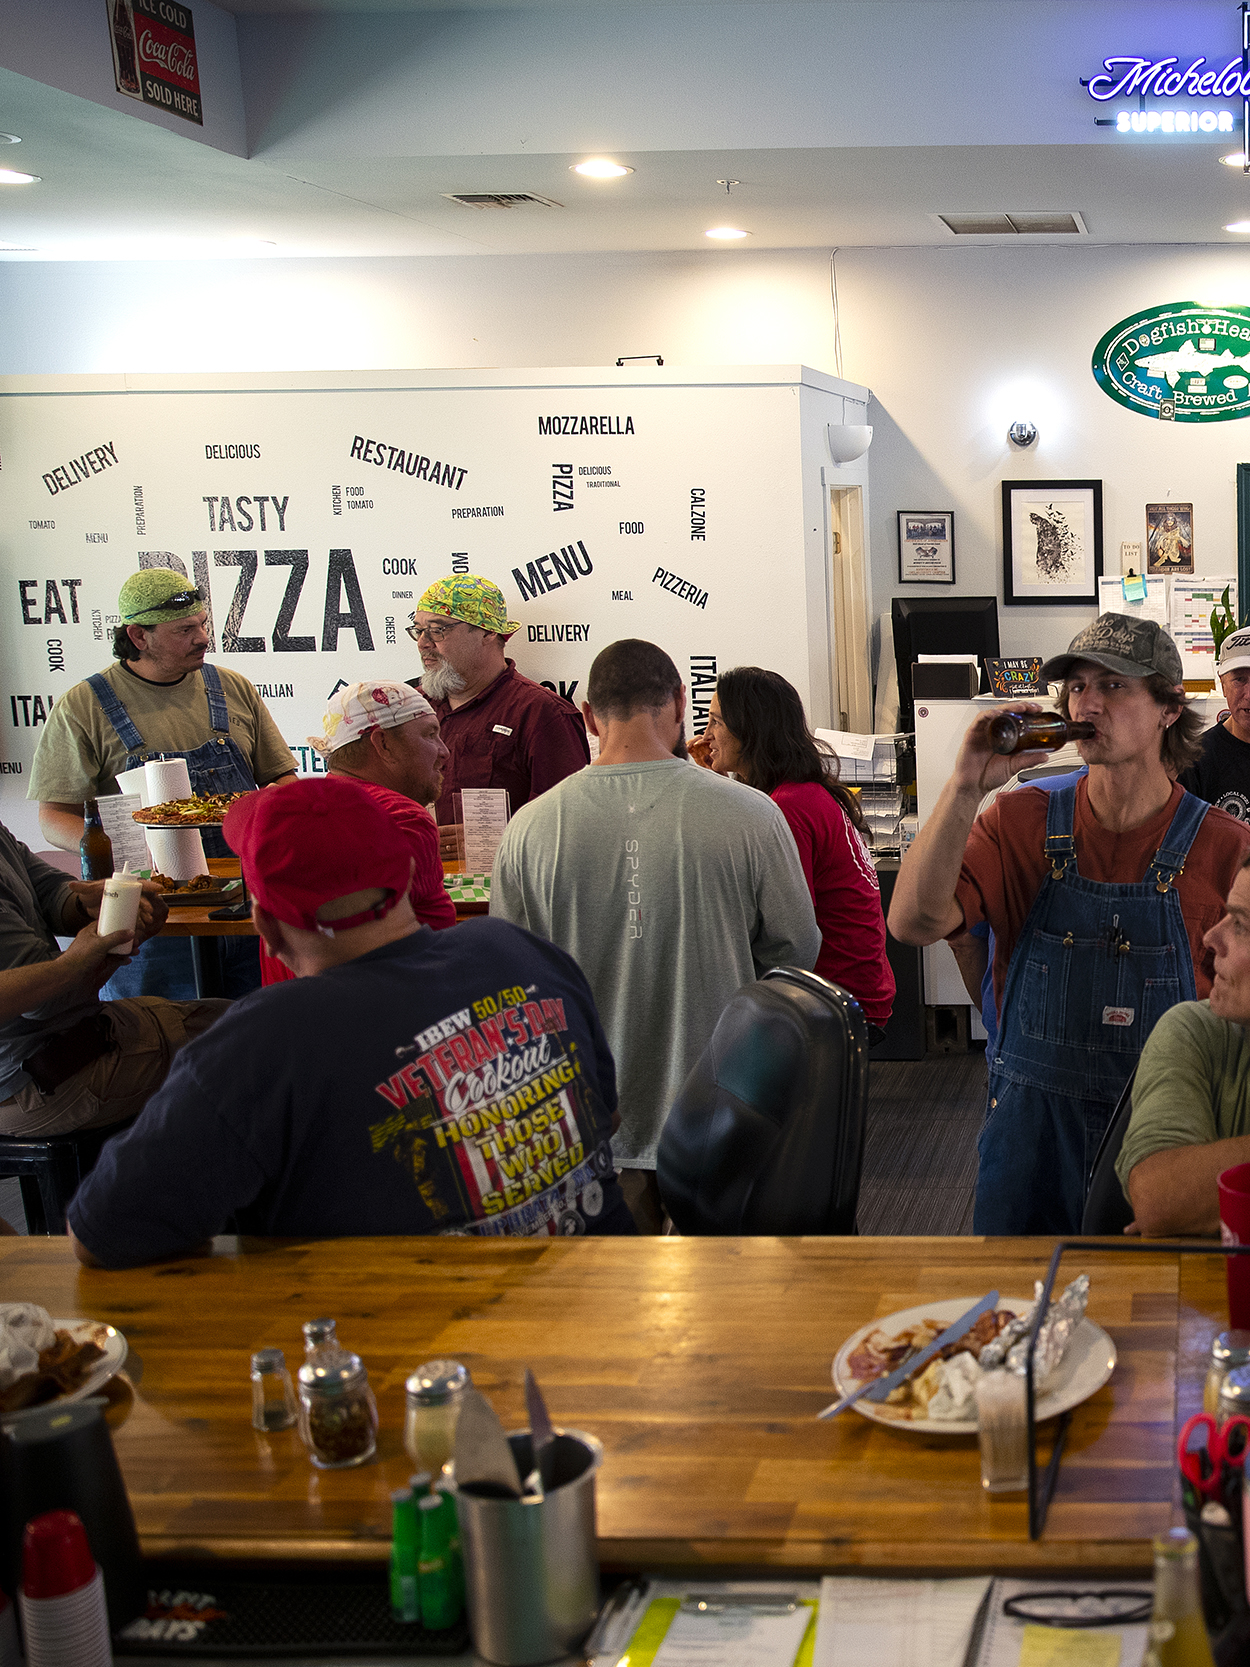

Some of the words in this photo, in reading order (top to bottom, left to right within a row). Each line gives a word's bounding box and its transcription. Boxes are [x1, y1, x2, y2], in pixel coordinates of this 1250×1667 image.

[160, 2, 187, 29] COLD
[145, 80, 172, 105] SOLD
[173, 91, 199, 117] HERE
[1116, 110, 1234, 133] SUPERIOR
[1121, 370, 1163, 400] Craft
[1172, 389, 1238, 406] Brewed
[538, 416, 635, 435] MOZZARELLA
[205, 444, 261, 459] DELICIOUS
[350, 435, 468, 491] RESTAURANT
[41, 441, 120, 496] DELIVERY
[578, 466, 612, 476] DELICIOUS
[332, 484, 343, 516] KITCHEN
[345, 486, 365, 497] FOOD
[552, 463, 574, 512] PIZZA
[136, 485, 147, 536] PREPARATION
[202, 496, 290, 532] TASTY
[346, 499, 375, 510] TOMATO
[451, 506, 504, 519] PREPARATION
[690, 488, 706, 542] CALZONE
[28, 519, 56, 531] TOMATO
[85, 532, 109, 544] MENU
[619, 521, 644, 535] FOOD
[382, 558, 418, 576] COOK
[511, 540, 594, 602] MENU
[18, 579, 83, 626] EAT
[392, 590, 414, 600] DINNER
[611, 591, 634, 602] MEAL
[652, 566, 710, 610] PIZZERIA
[91, 609, 104, 641] KITCHEN
[385, 616, 397, 645] CHEESE
[527, 624, 590, 643] DELIVERY
[46, 639, 66, 673] COOK
[1008, 661, 1020, 669] MAY
[1020, 660, 1028, 669] BE
[1004, 671, 1034, 682] CRAZY
[625, 839, 643, 939] SPYDER
[413, 1007, 472, 1052] IBEW
[472, 985, 528, 1019] 50/50
[375, 1007, 530, 1110] VETERAN'S
[522, 998, 569, 1038] DAY
[444, 1033, 551, 1112] Cookout
[433, 1061, 575, 1149] HONORING
[475, 1096, 566, 1160] THOSE
[500, 1129, 563, 1180] WHO
[481, 1142, 584, 1215] SERVED
